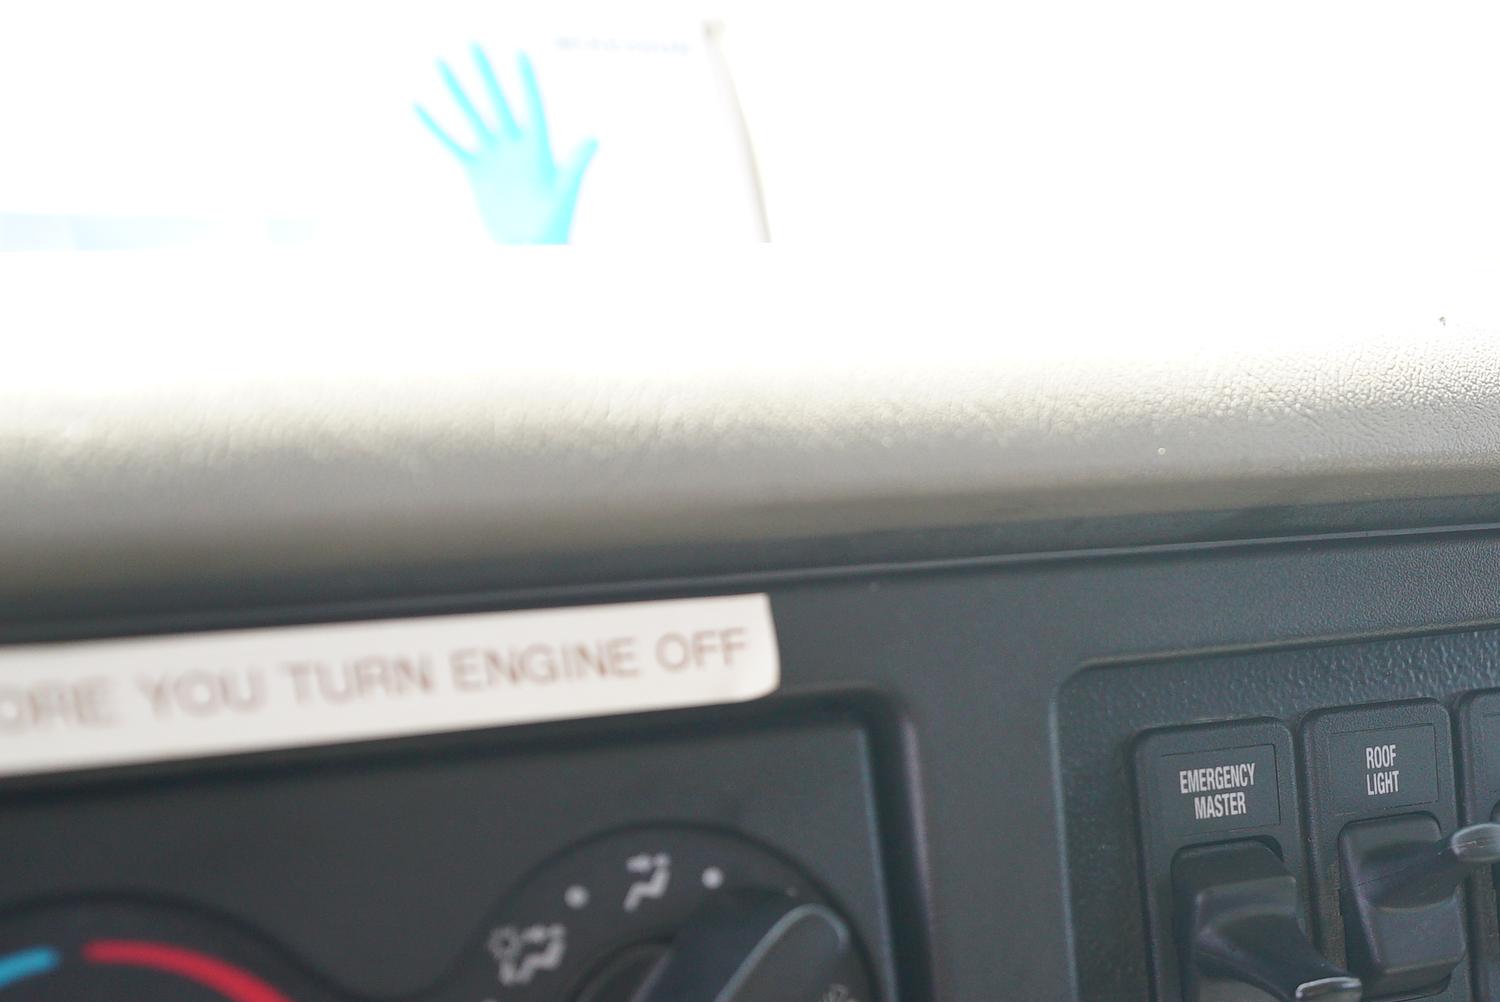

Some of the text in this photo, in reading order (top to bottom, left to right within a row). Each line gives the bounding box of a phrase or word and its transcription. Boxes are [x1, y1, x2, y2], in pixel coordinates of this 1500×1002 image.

[138, 665, 266, 720] YOU
[281, 653, 433, 706] TURN
[451, 636, 640, 692] ENGINE
[655, 626, 748, 674] OFF
[1365, 744, 1397, 769] ROOF
[1179, 762, 1256, 794] EMERGENCY
[1366, 770, 1400, 796] LIGHT
[1194, 791, 1247, 820] MASTER
